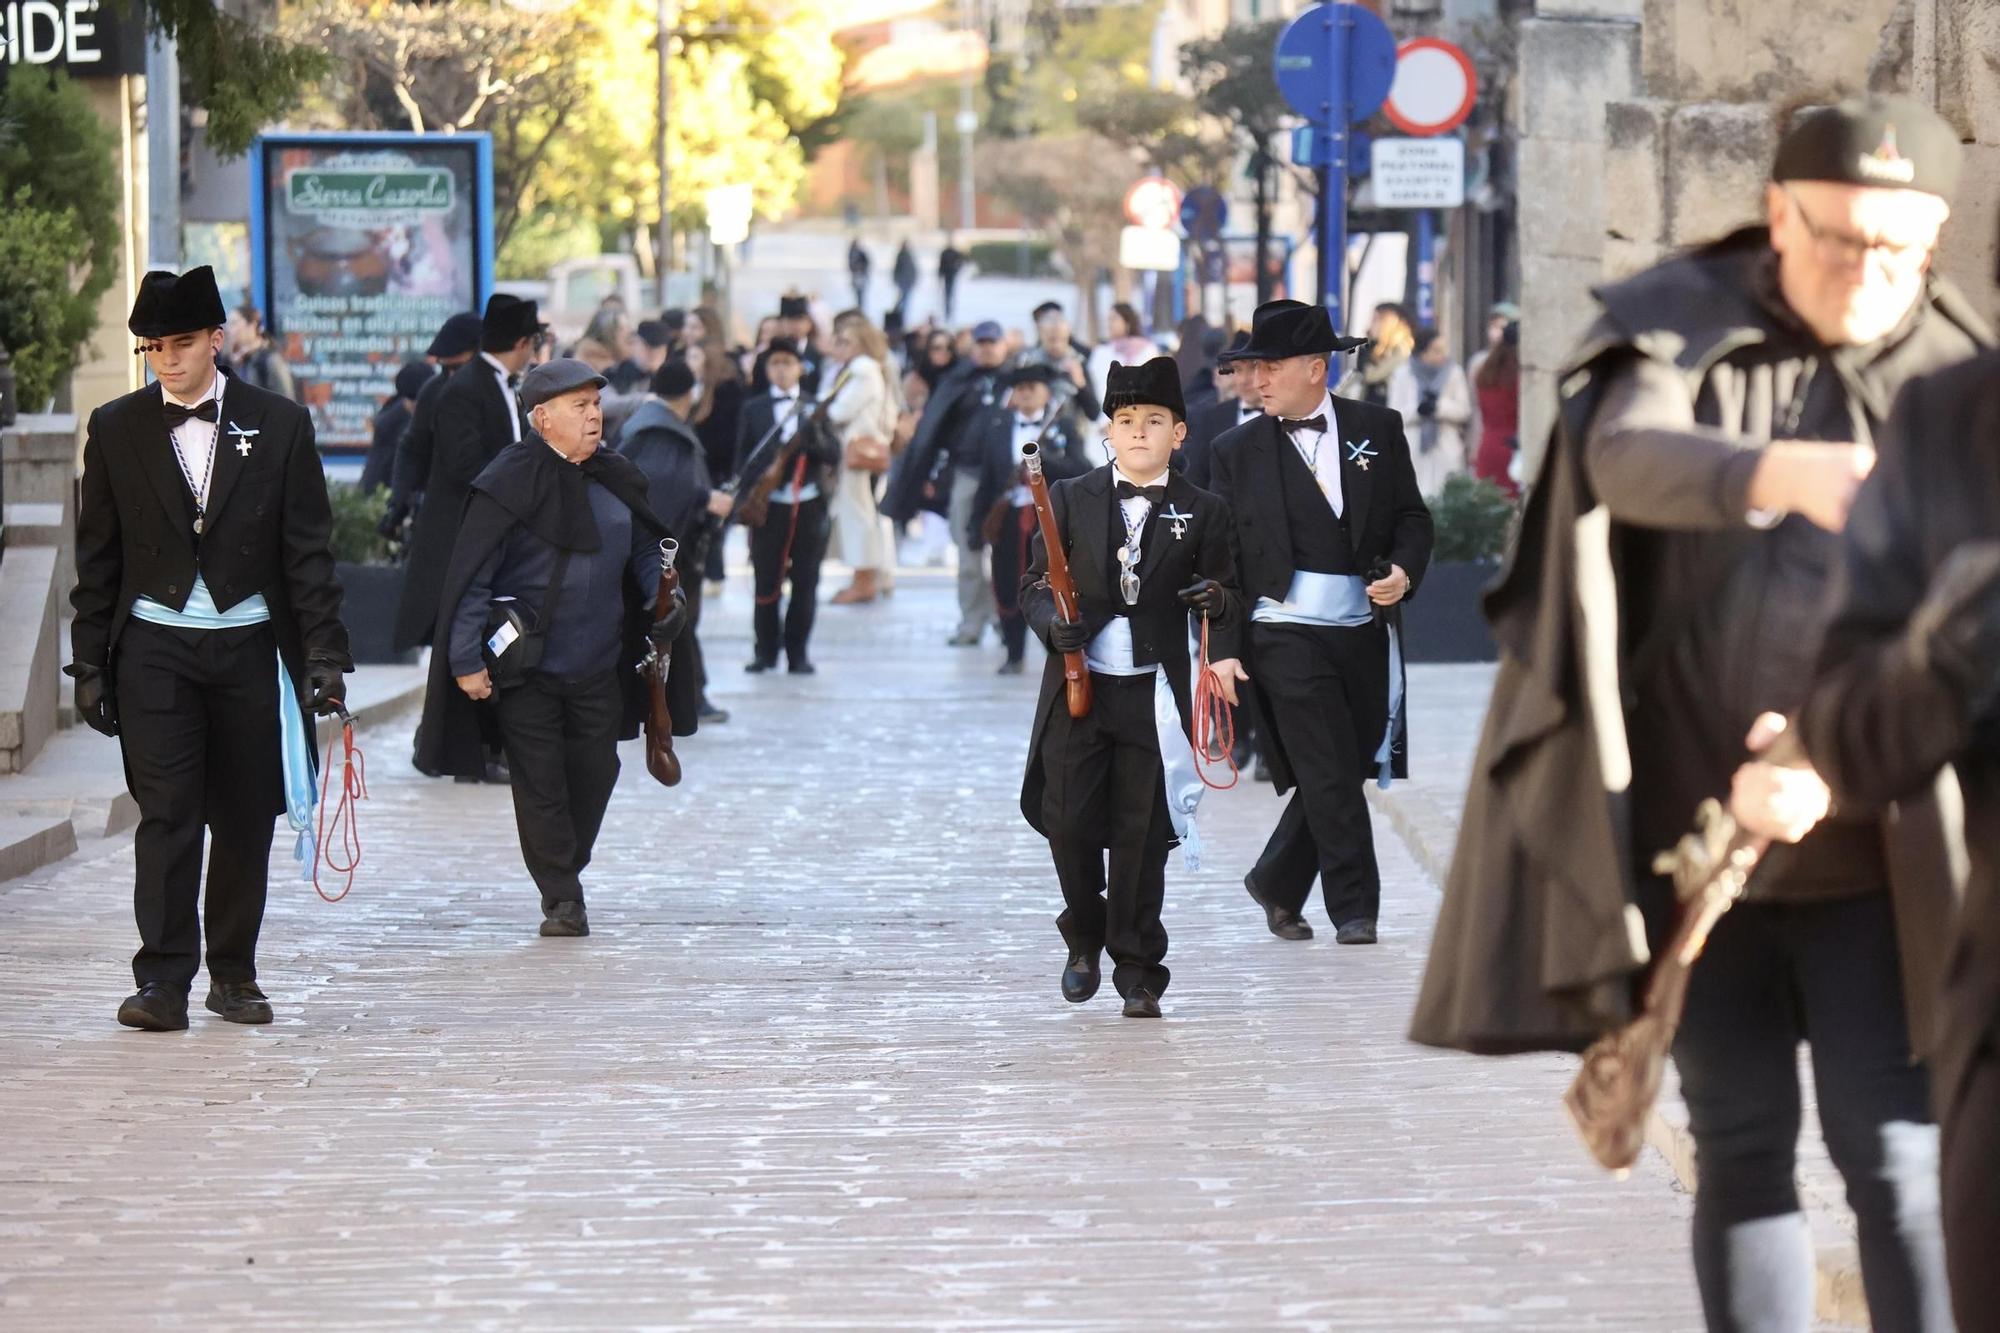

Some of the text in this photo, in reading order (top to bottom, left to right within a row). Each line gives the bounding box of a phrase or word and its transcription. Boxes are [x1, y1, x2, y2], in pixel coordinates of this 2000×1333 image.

[0, 0, 101, 64] IDE
[294, 174, 448, 206] Sierra Cazorla
[295, 293, 451, 312] Guisos tradicionales
[283, 315, 339, 333] hechos
[341, 318, 363, 332] en
[365, 315, 396, 333] olla
[303, 337, 314, 355] y
[315, 334, 395, 352] cocinados
[397, 338, 409, 352] a
